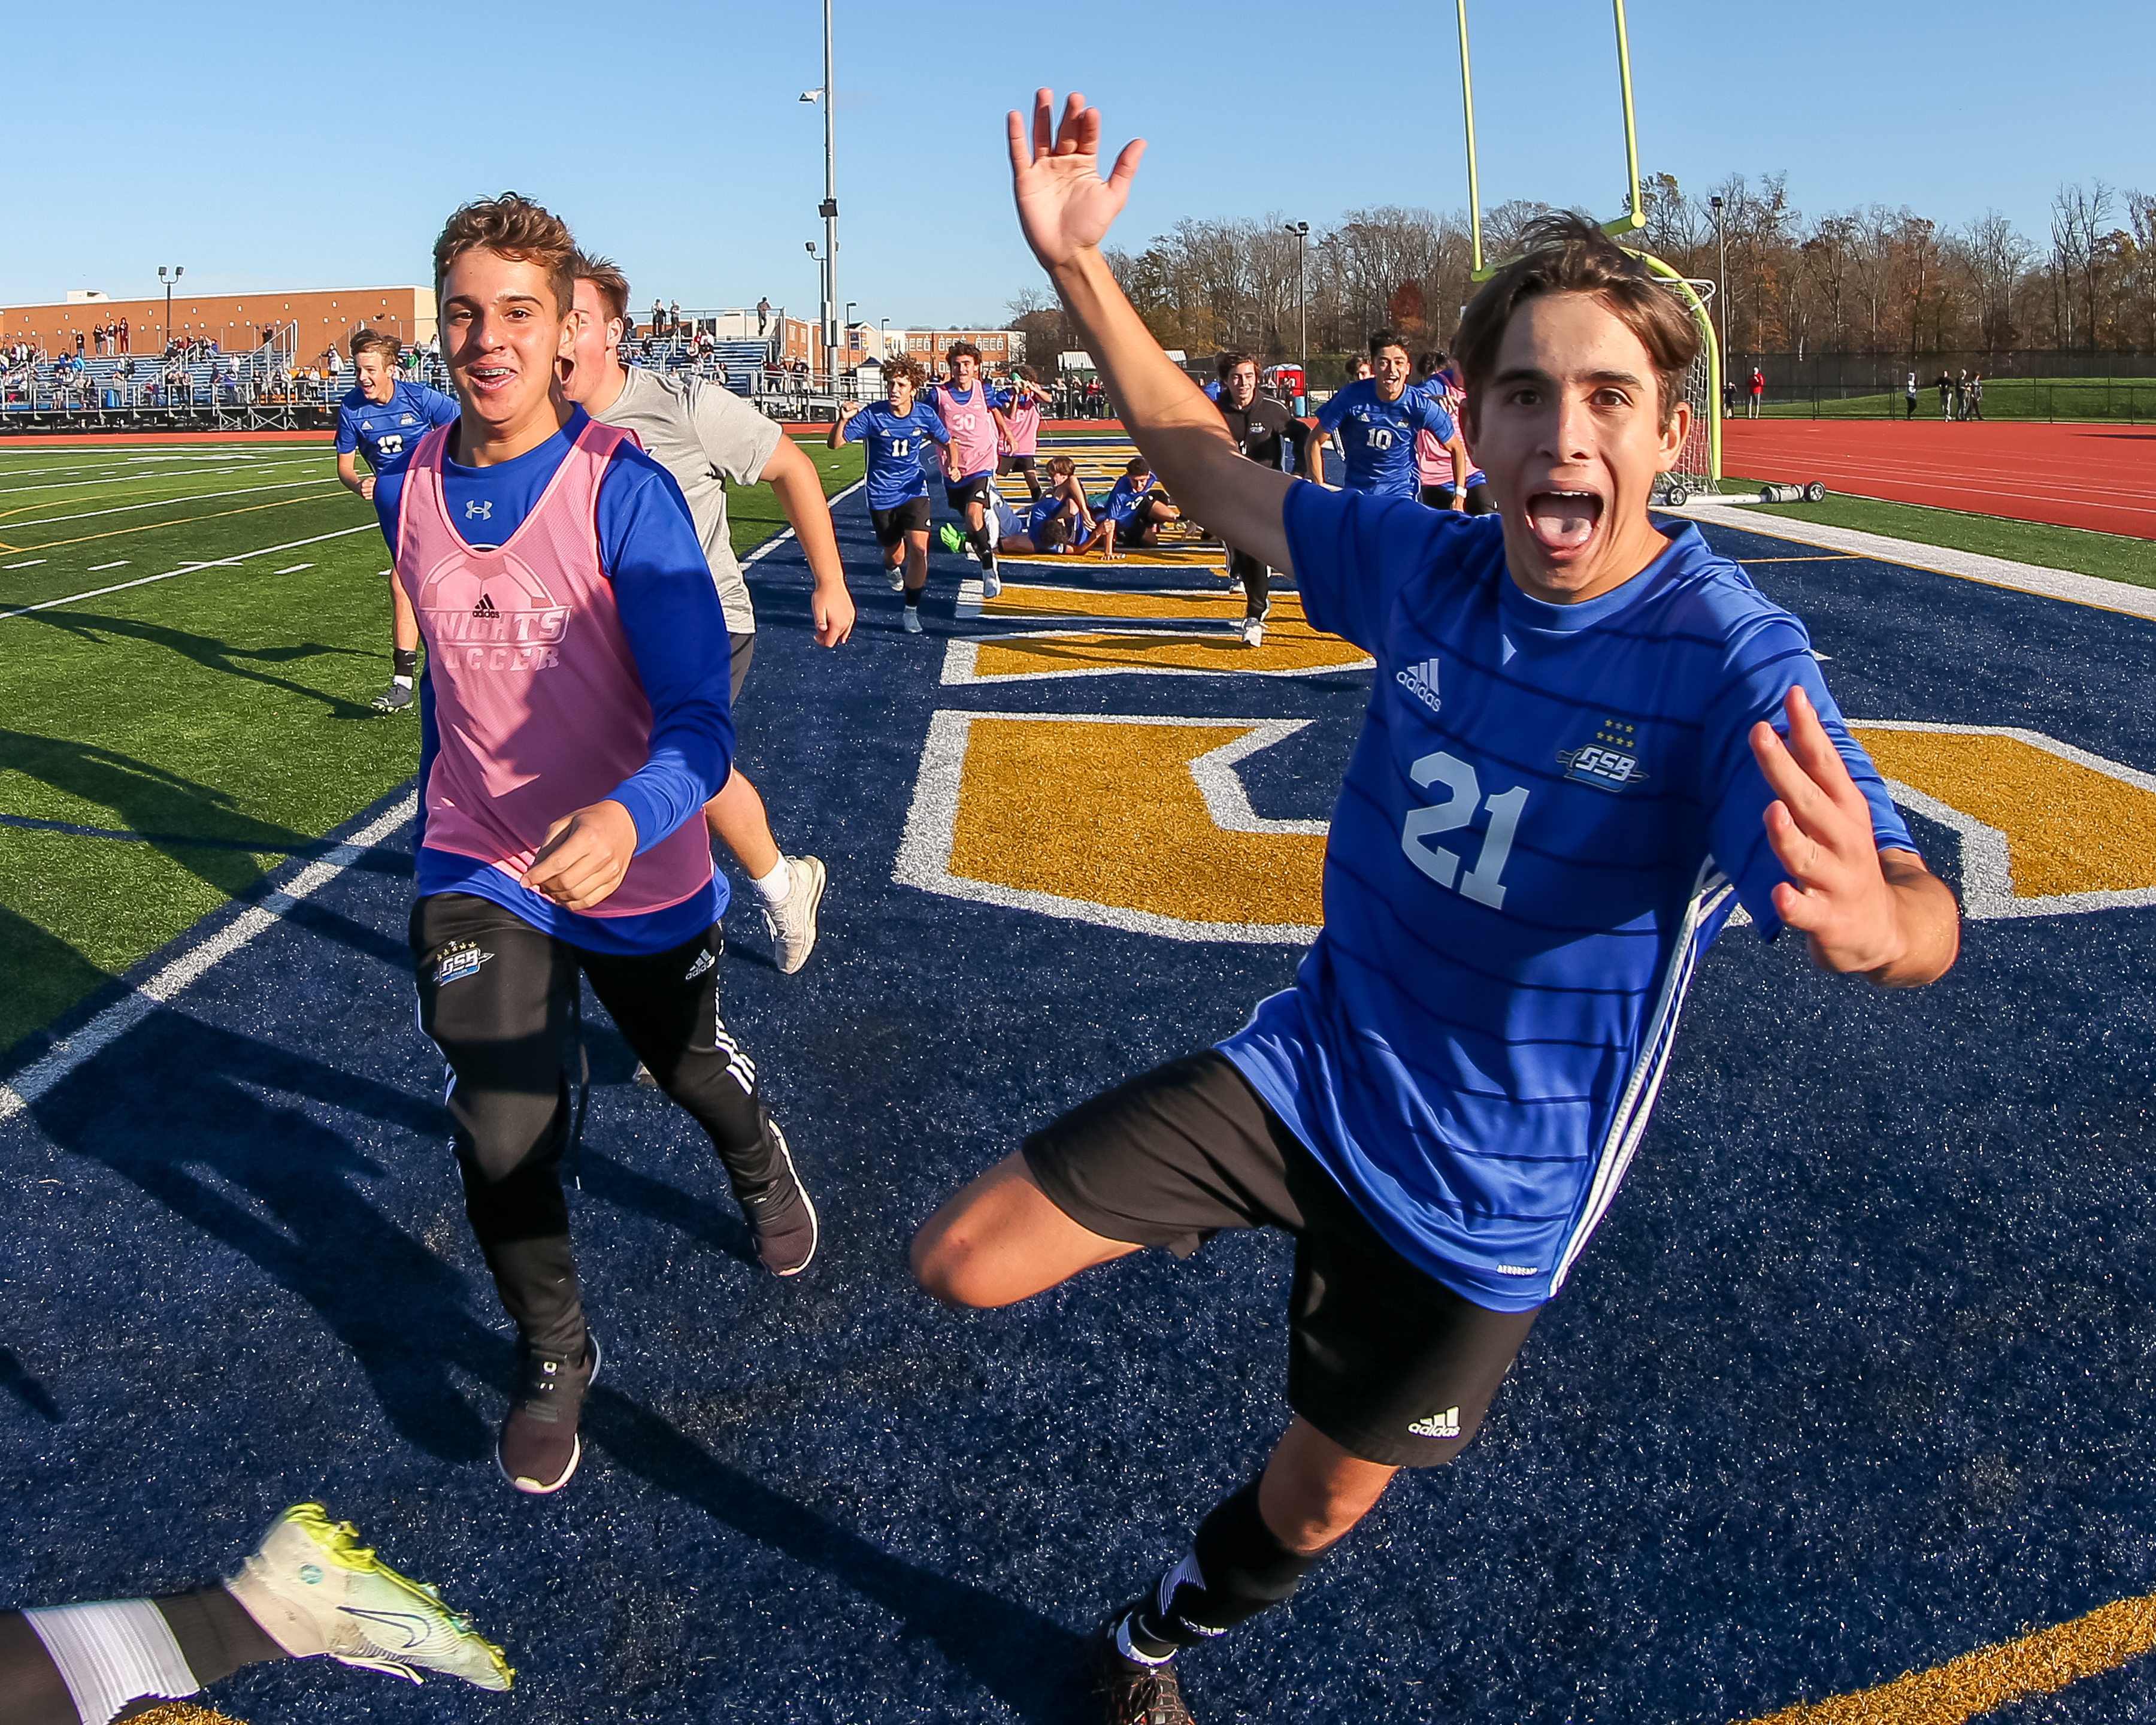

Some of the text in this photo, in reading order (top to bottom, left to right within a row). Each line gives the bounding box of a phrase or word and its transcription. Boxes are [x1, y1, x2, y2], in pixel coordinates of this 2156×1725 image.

[952, 413, 975, 431] 30
[891, 438, 909, 457] 11
[1366, 428, 1392, 450] 10
[429, 610, 565, 640] NIGHTS
[1396, 671, 1441, 712] adidas
[1575, 746, 1636, 782] GSB
[1401, 751, 1530, 910] 21
[441, 949, 479, 977] GSB
[1408, 1423, 1461, 1437] adidas
